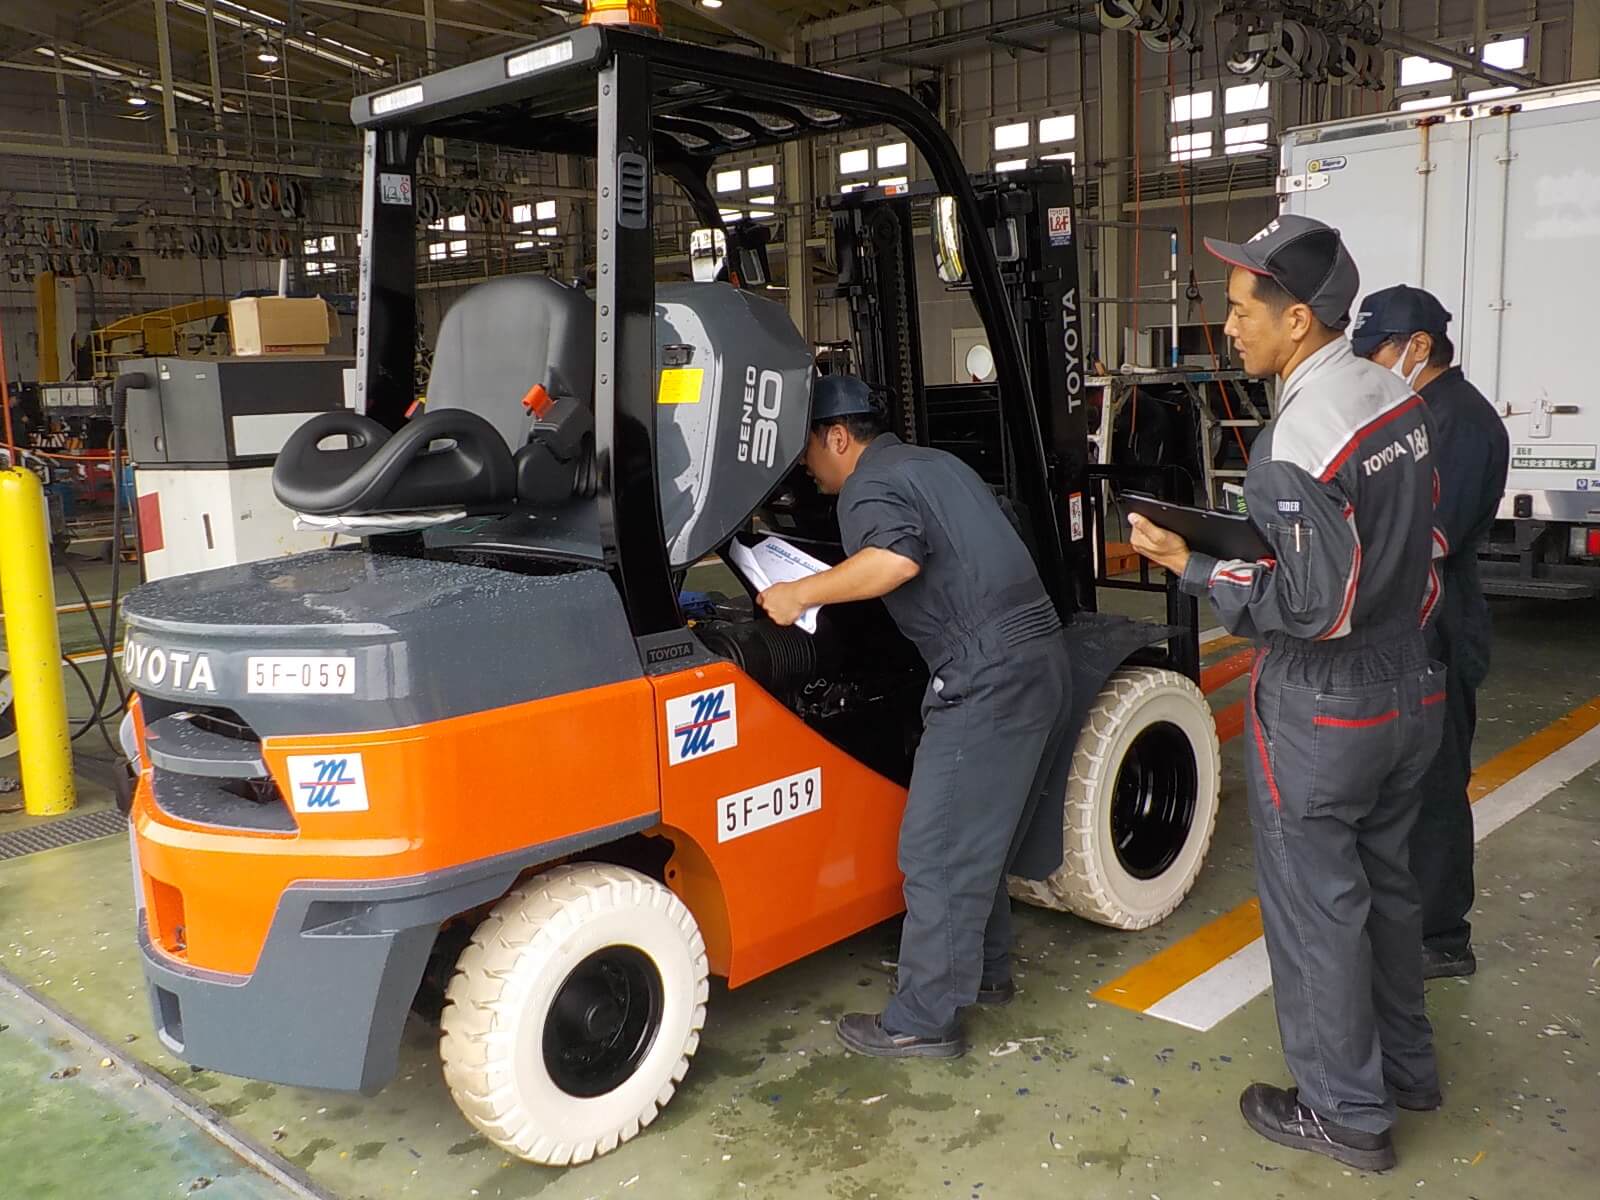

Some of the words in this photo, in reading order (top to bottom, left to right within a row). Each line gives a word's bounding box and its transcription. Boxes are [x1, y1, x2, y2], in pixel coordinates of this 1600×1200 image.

[1050, 216, 1069, 232] L&F
[1062, 287, 1081, 414] TOYOTA
[737, 365, 756, 462] GENEO
[751, 369, 783, 468] 30
[1362, 440, 1408, 476] TOYOTA
[125, 640, 216, 692] OYOTA
[256, 663, 346, 687] 5F-059
[649, 645, 691, 661] TOYOTA
[726, 778, 815, 832] 5F-059
